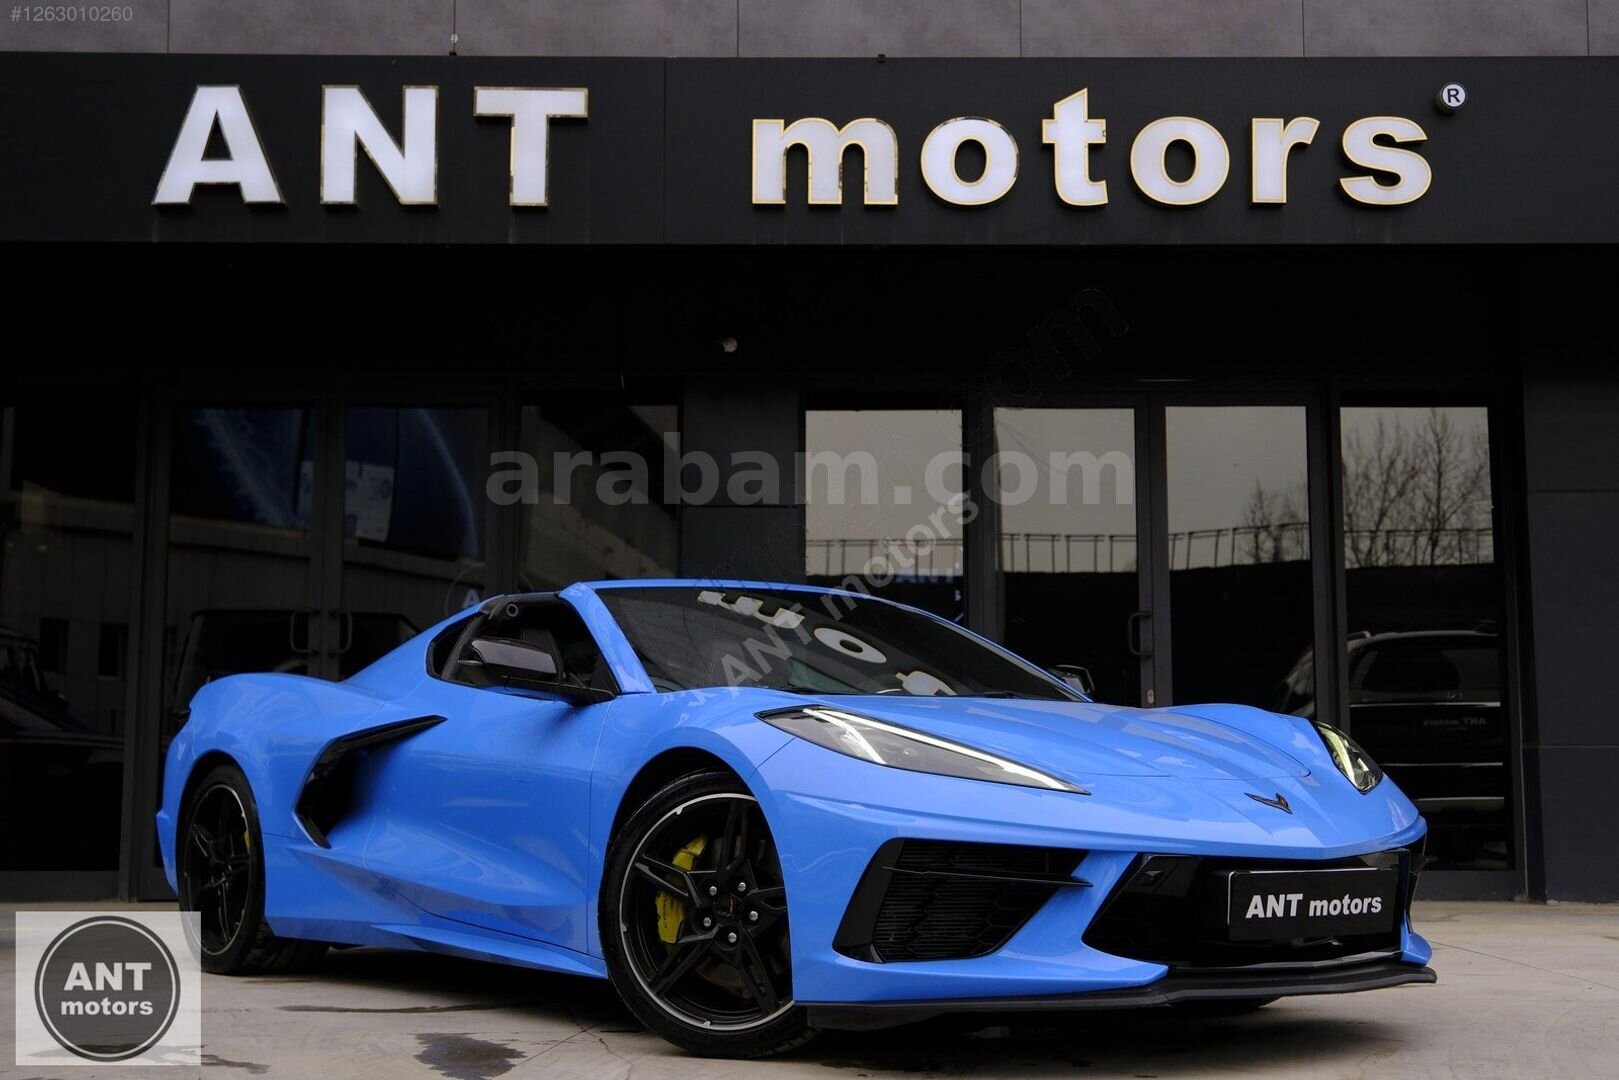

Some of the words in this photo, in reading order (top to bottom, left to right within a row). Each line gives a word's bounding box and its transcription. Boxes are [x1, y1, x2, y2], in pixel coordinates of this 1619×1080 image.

[150, 84, 589, 207] ANT
[752, 87, 1433, 207] motors
[1245, 893, 1303, 919] ANT
[1308, 893, 1382, 917] motors
